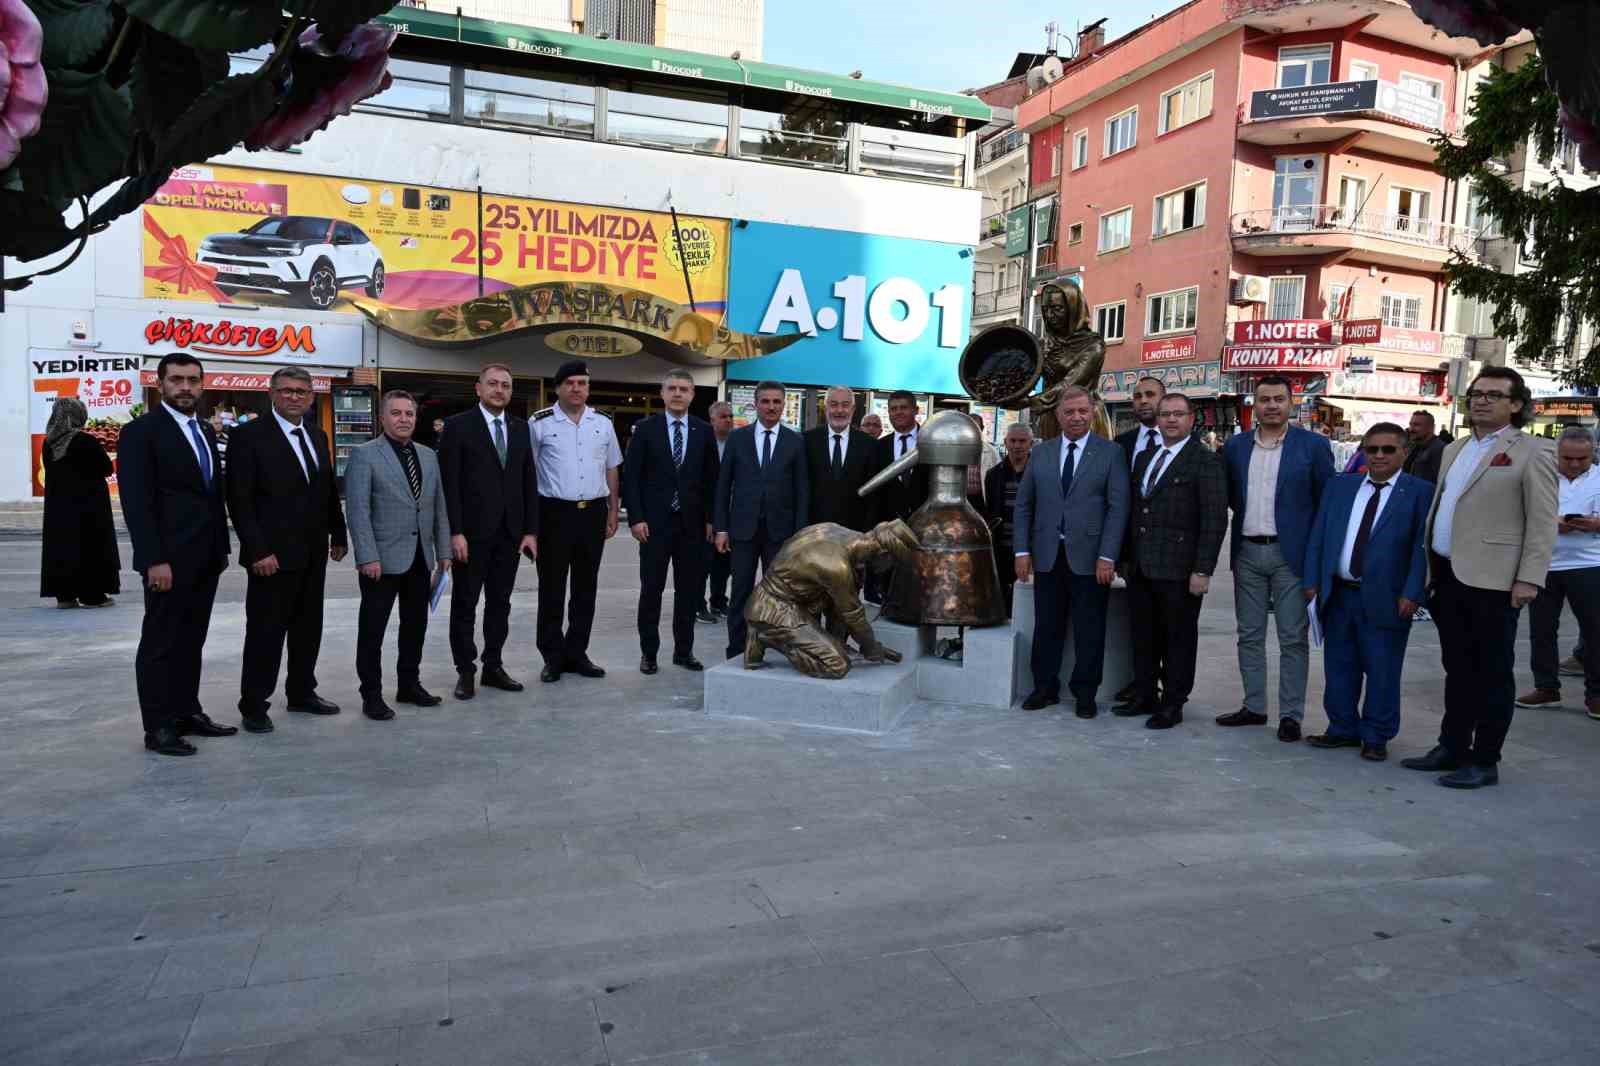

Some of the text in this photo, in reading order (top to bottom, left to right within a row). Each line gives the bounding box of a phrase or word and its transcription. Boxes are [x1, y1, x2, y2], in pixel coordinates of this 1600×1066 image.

[202, 183, 248, 199] ADET
[156, 193, 205, 209] OPEL
[485, 203, 658, 244] 25.YILIMIZDA
[450, 228, 657, 280] 25 HEDİYE
[758, 268, 965, 349] A.101
[1246, 322, 1320, 340] 1.NOTER
[1345, 324, 1377, 338] 1.NOTER
[566, 334, 624, 353] OTEL
[32, 354, 140, 374] YEDİRTEN
[1230, 349, 1279, 367] KONYA
[1284, 349, 1339, 367] PAZARI
[88, 395, 133, 408] HEDİYE
